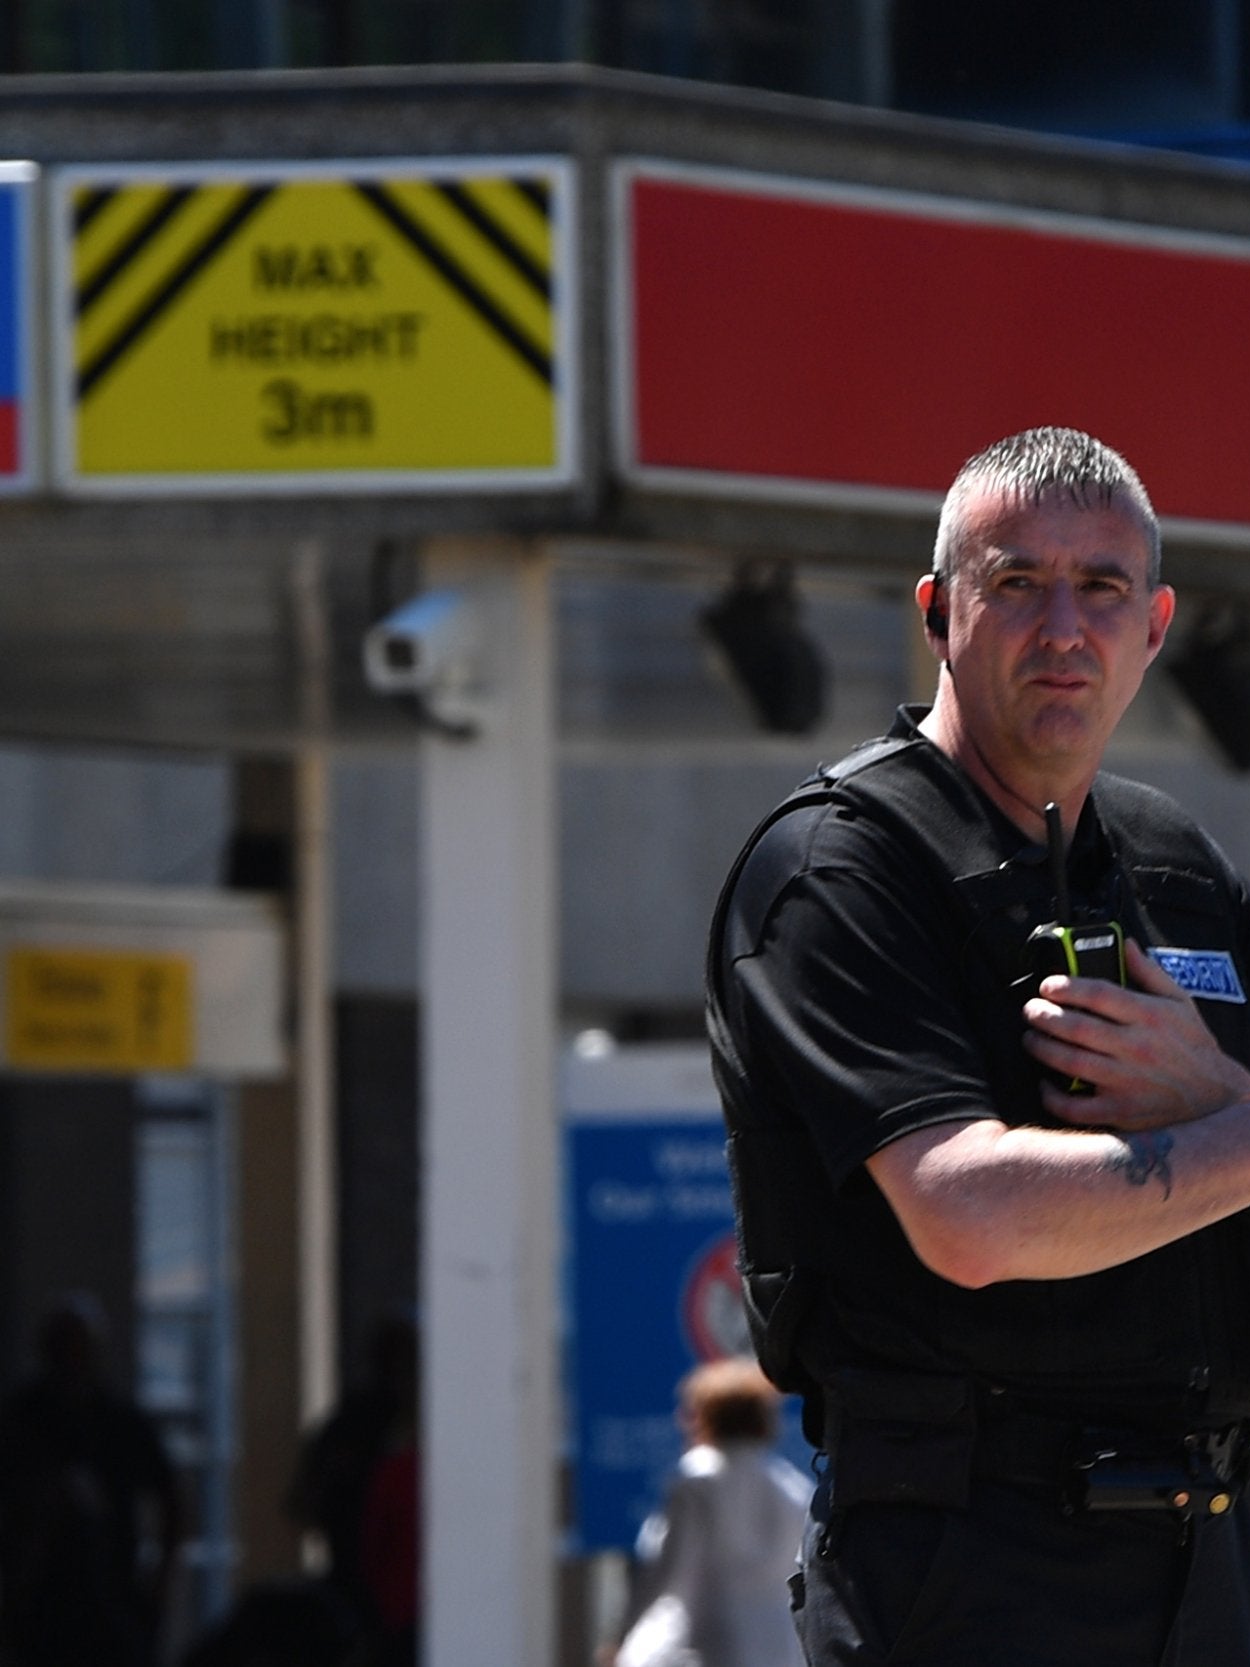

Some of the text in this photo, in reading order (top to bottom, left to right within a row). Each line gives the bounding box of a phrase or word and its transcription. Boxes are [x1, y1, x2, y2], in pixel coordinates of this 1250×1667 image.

[256, 246, 374, 290] MAX
[210, 311, 422, 363] HEIGHT
[260, 380, 375, 446] 3m
